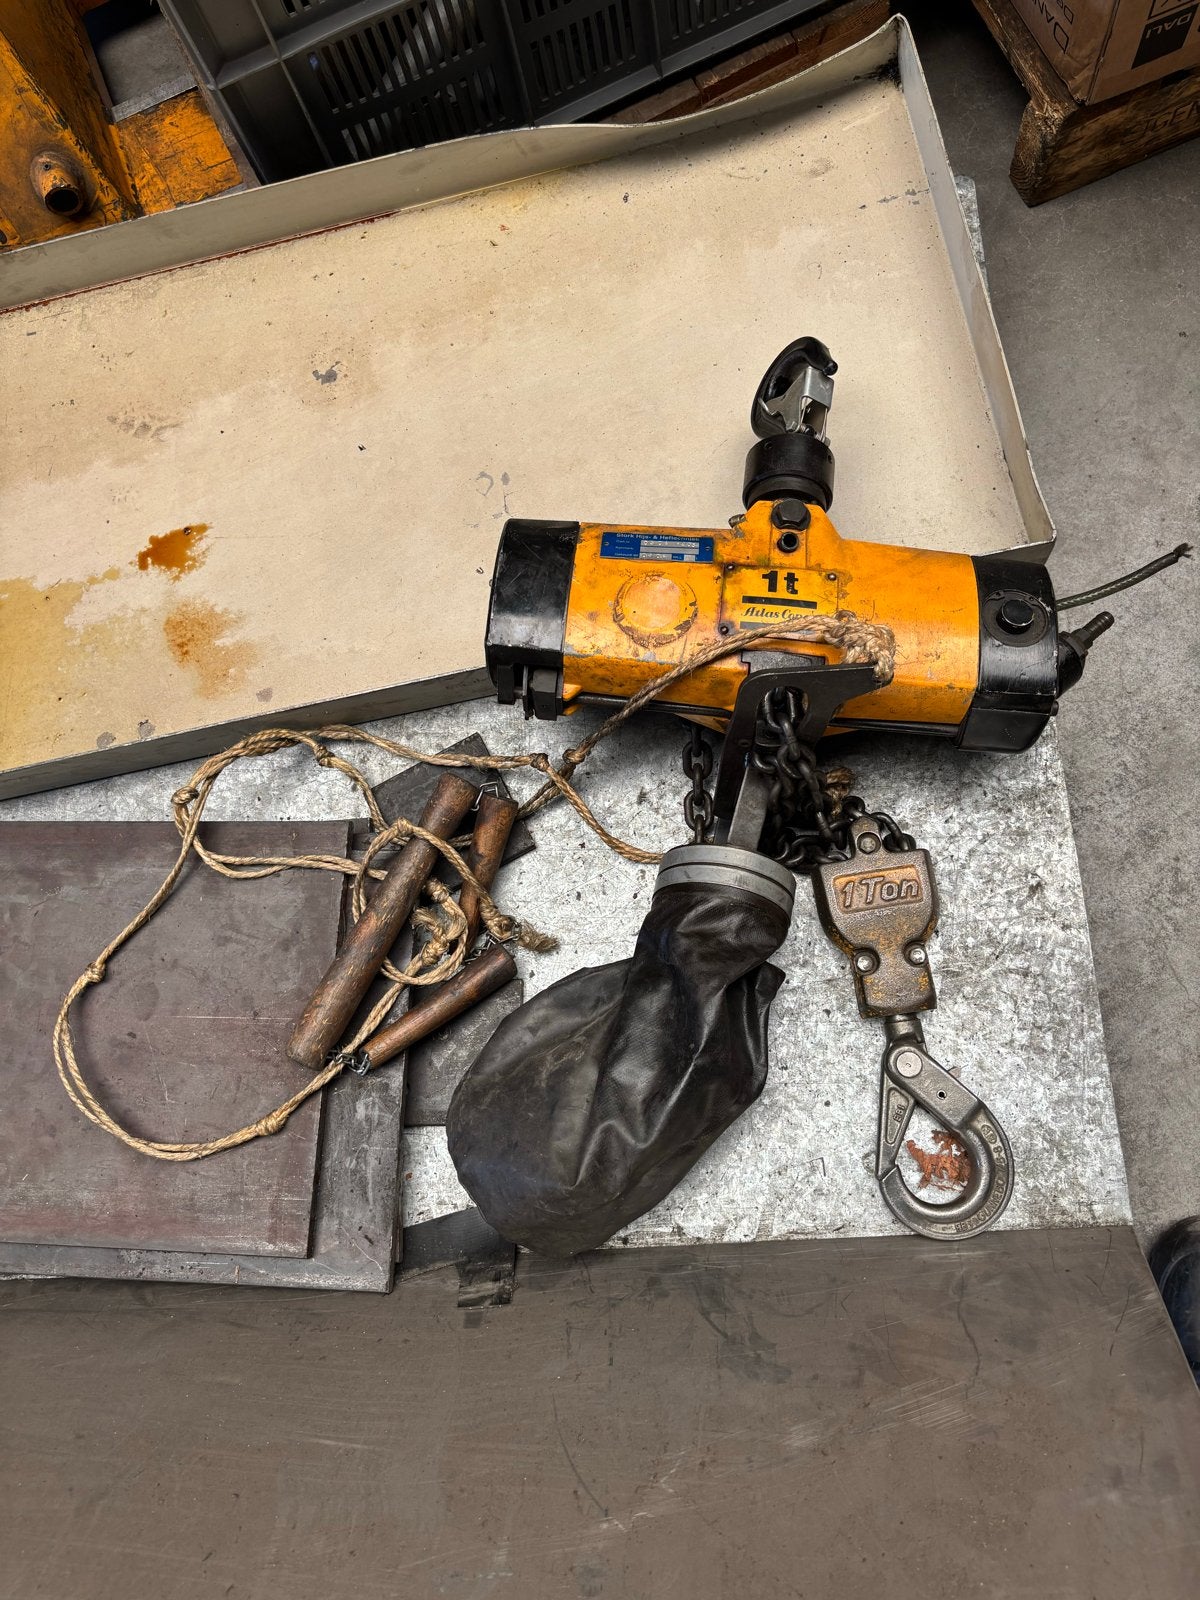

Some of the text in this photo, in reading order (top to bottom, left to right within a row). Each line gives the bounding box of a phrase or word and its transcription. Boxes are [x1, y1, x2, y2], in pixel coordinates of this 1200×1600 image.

[1033, 0, 1069, 54] DAN
[1145, 12, 1192, 39] DALI
[743, 607, 808, 621] Atlas Cop
[860, 875, 919, 904] Ton
